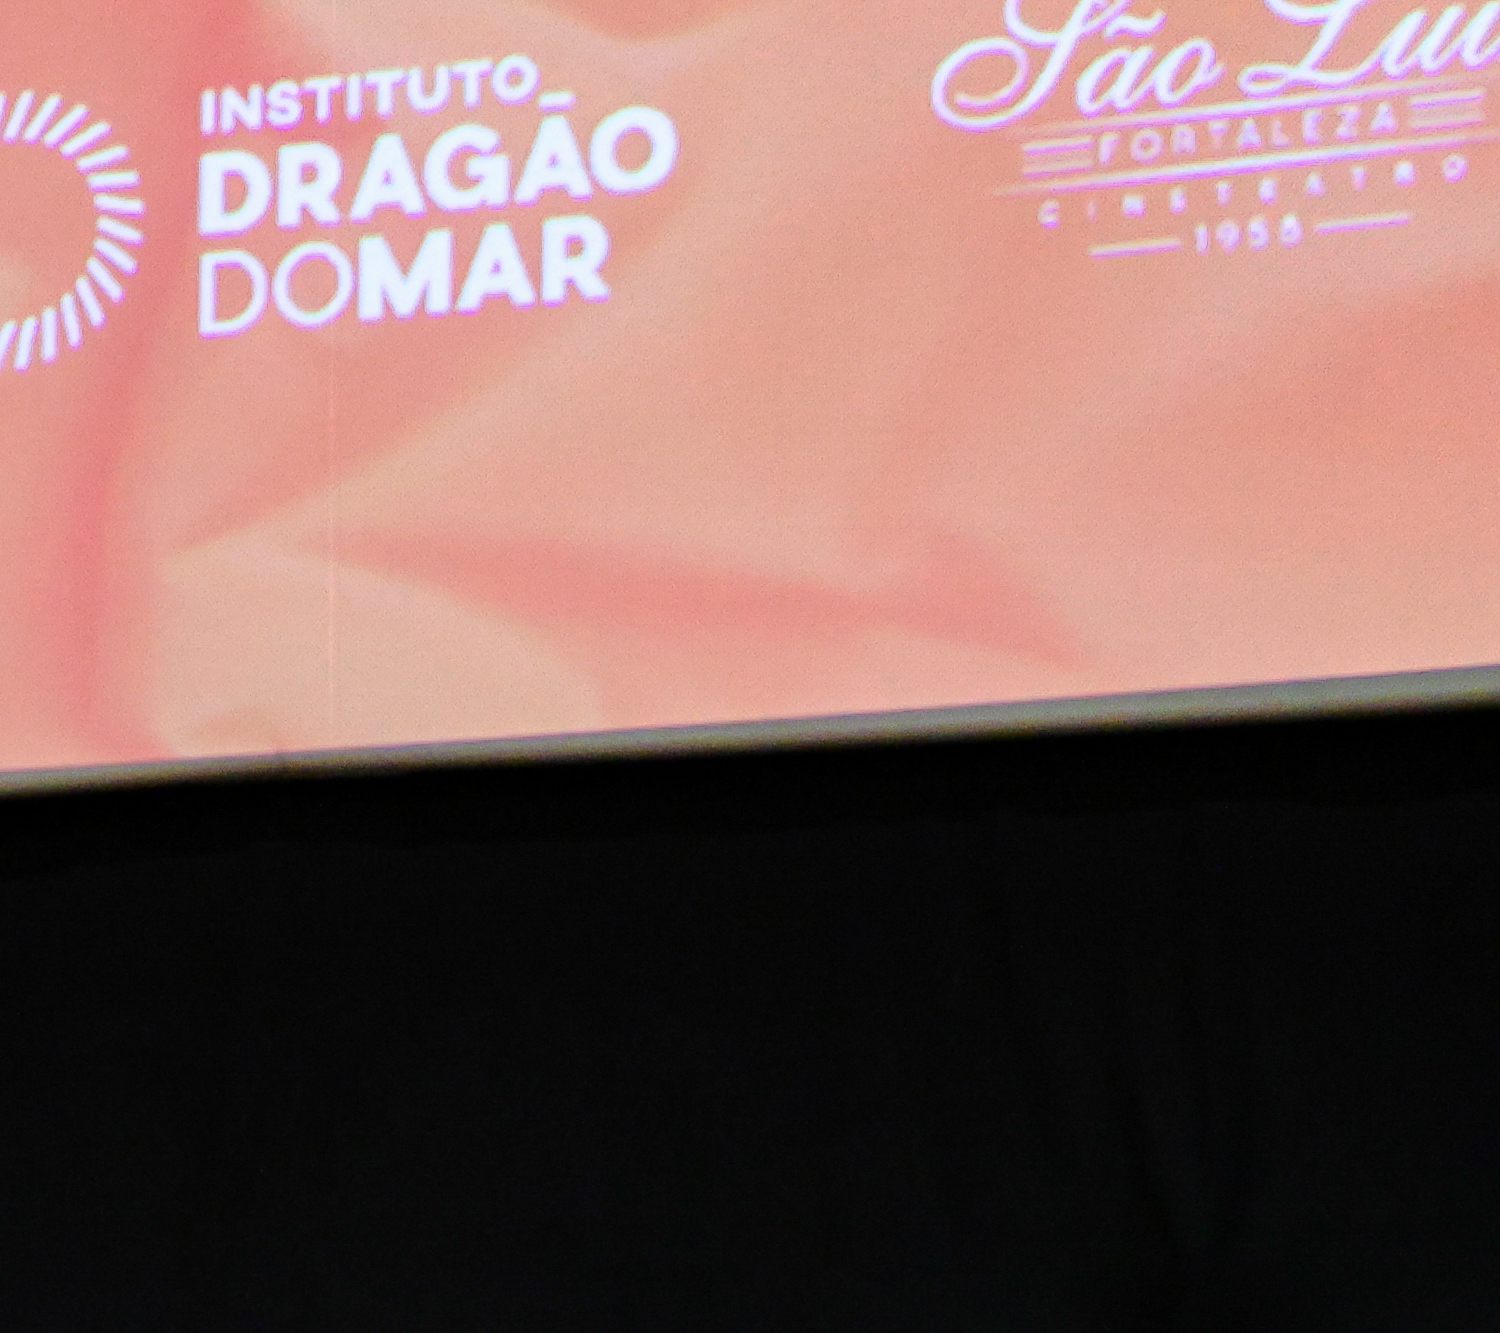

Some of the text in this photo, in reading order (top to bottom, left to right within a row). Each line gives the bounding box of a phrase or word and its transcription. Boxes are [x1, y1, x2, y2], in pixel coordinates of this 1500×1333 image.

[201, 55, 540, 136] INSTITUTO
[1098, 100, 1399, 166] FORTALEZA
[199, 91, 679, 236] DRAGÃO
